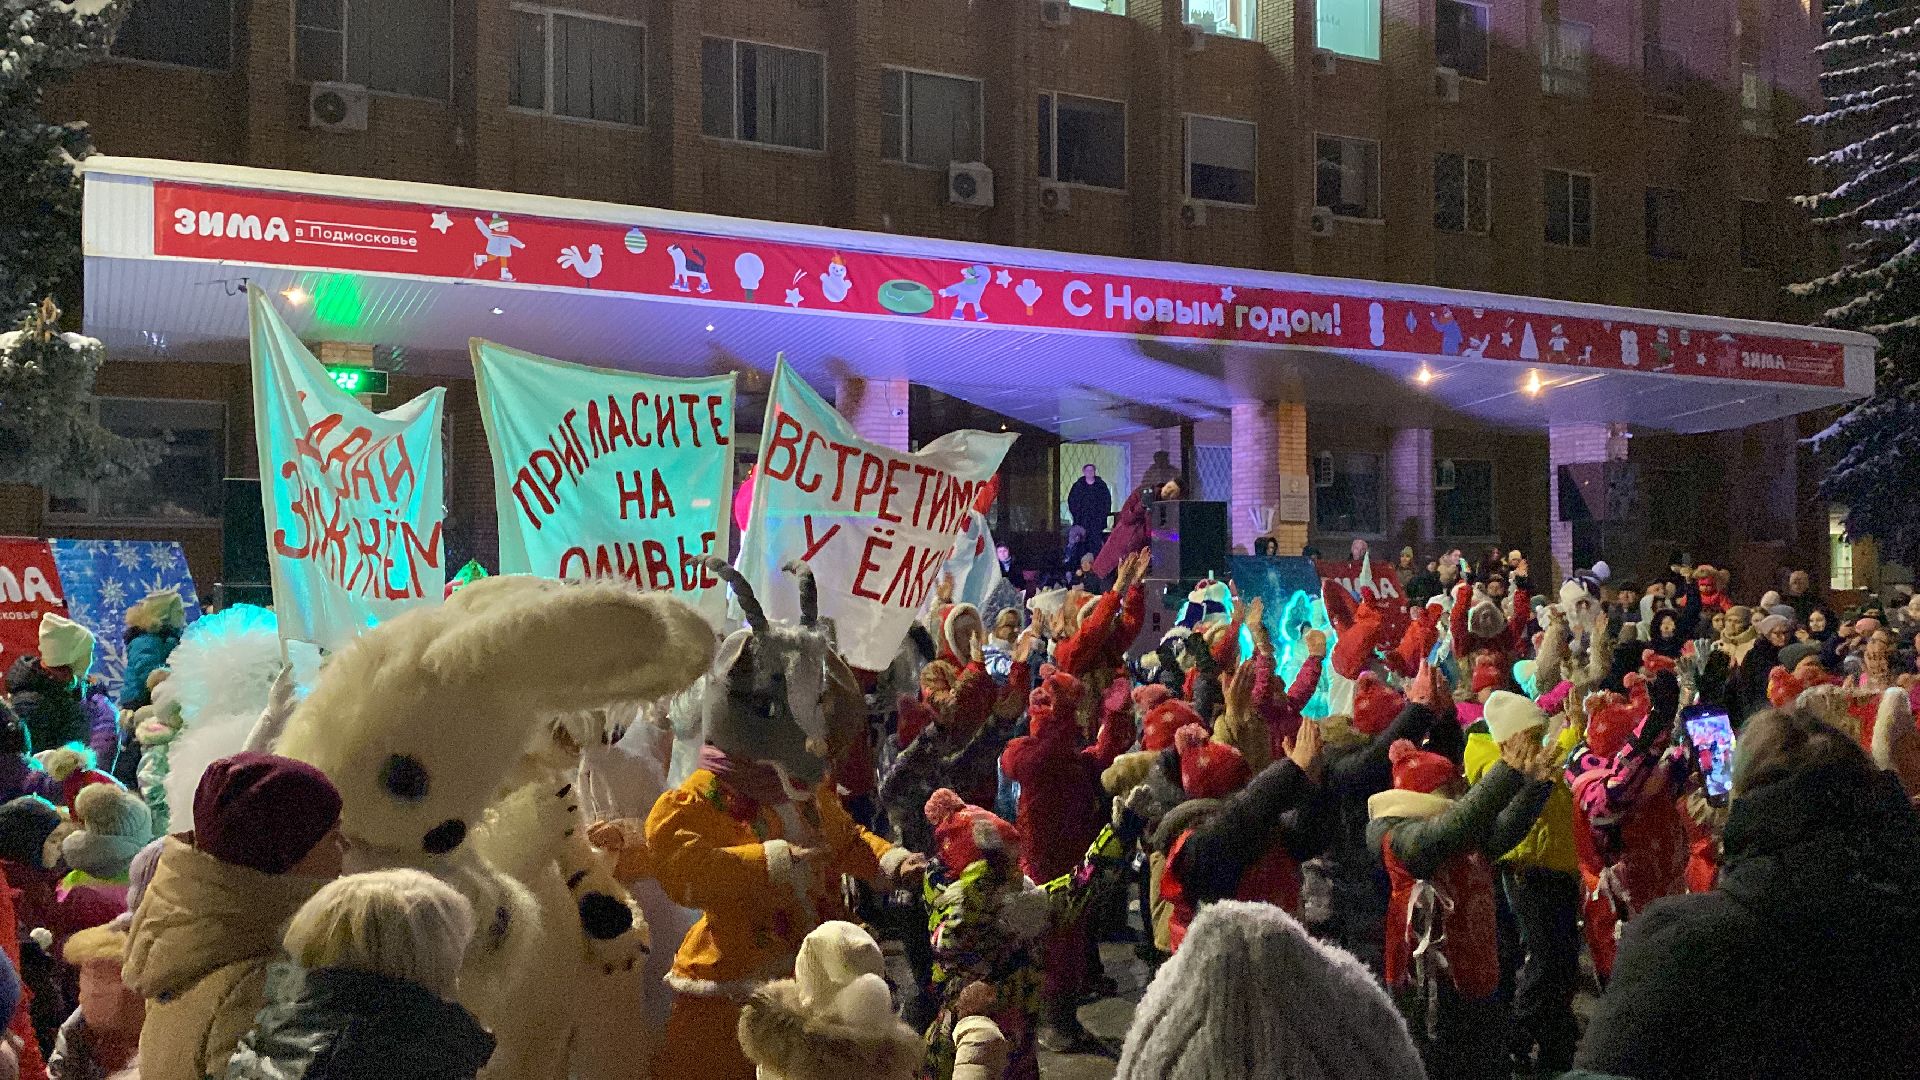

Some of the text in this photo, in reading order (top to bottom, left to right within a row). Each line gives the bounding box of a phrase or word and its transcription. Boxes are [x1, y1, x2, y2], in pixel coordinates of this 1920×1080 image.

[174, 207, 417, 247] ЗИМА в Подмосковье
[1062, 279, 1342, 337] С Новым годом!
[512, 391, 730, 530] ПРИГЛАСИТЕ
[615, 467, 676, 520] НА
[801, 514, 841, 562] У
